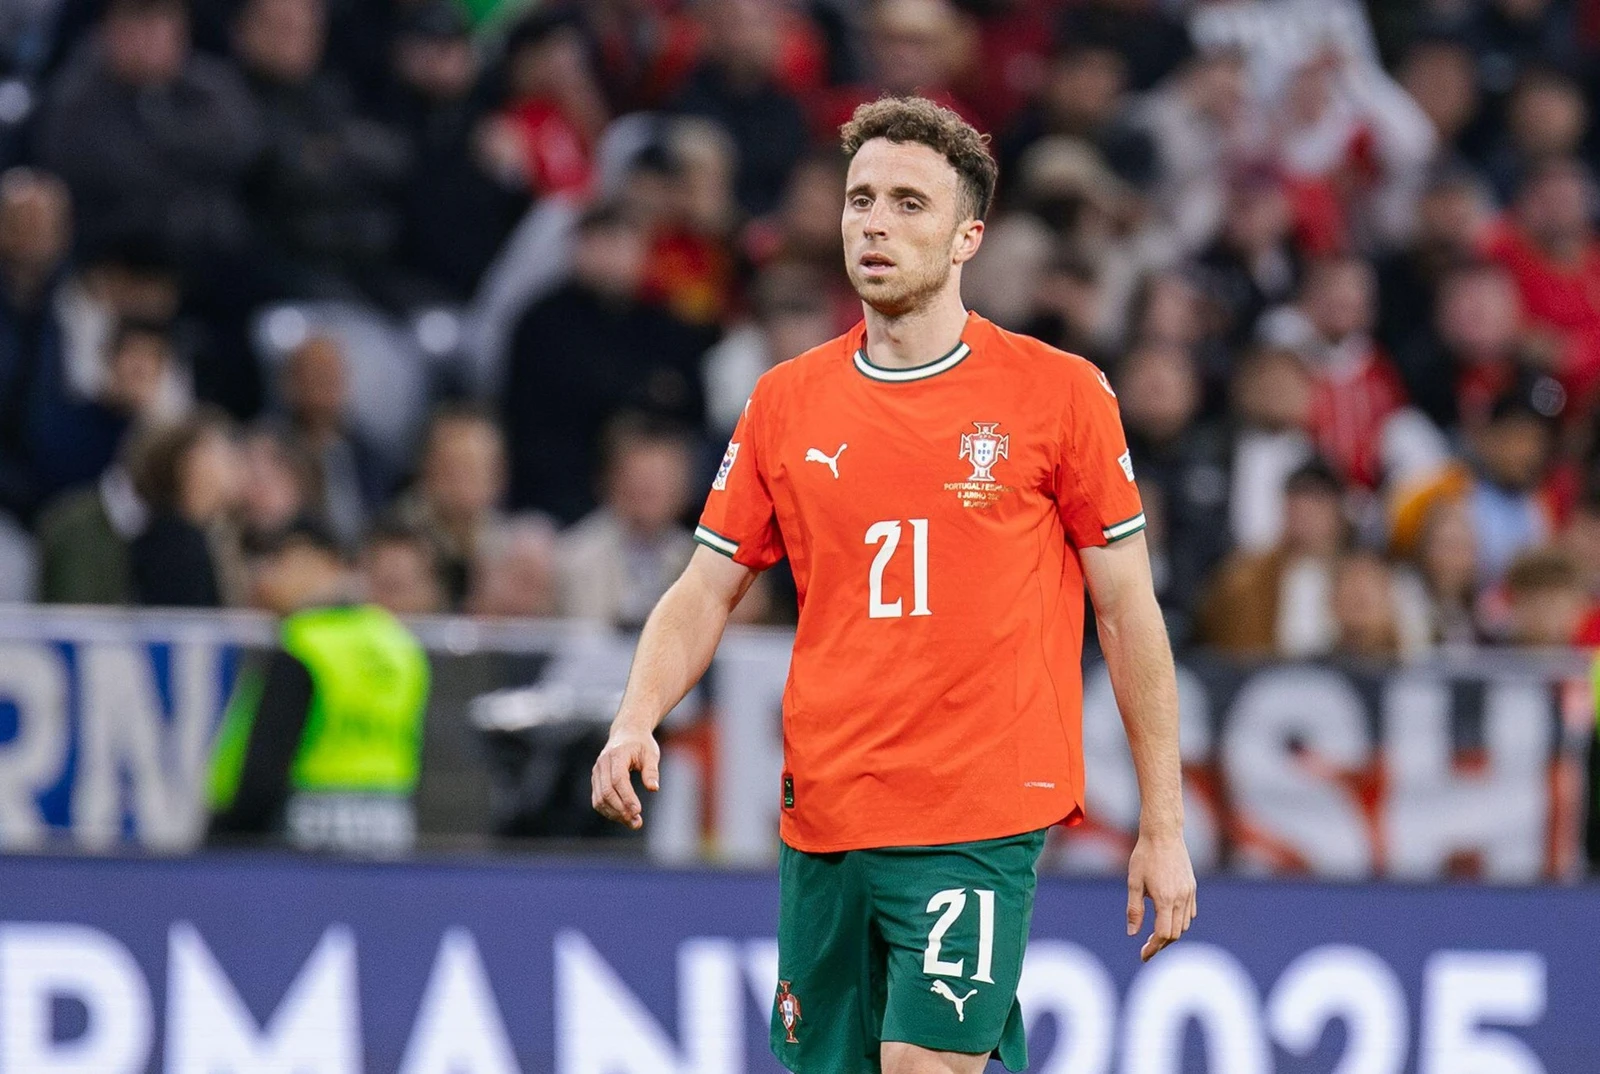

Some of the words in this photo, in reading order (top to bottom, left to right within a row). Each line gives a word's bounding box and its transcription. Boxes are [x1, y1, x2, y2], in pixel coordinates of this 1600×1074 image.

[944, 482, 980, 490] PORTUGAL
[864, 518, 933, 619] 21
[923, 887, 996, 985] 21
[1016, 938, 1551, 1074] 2025
